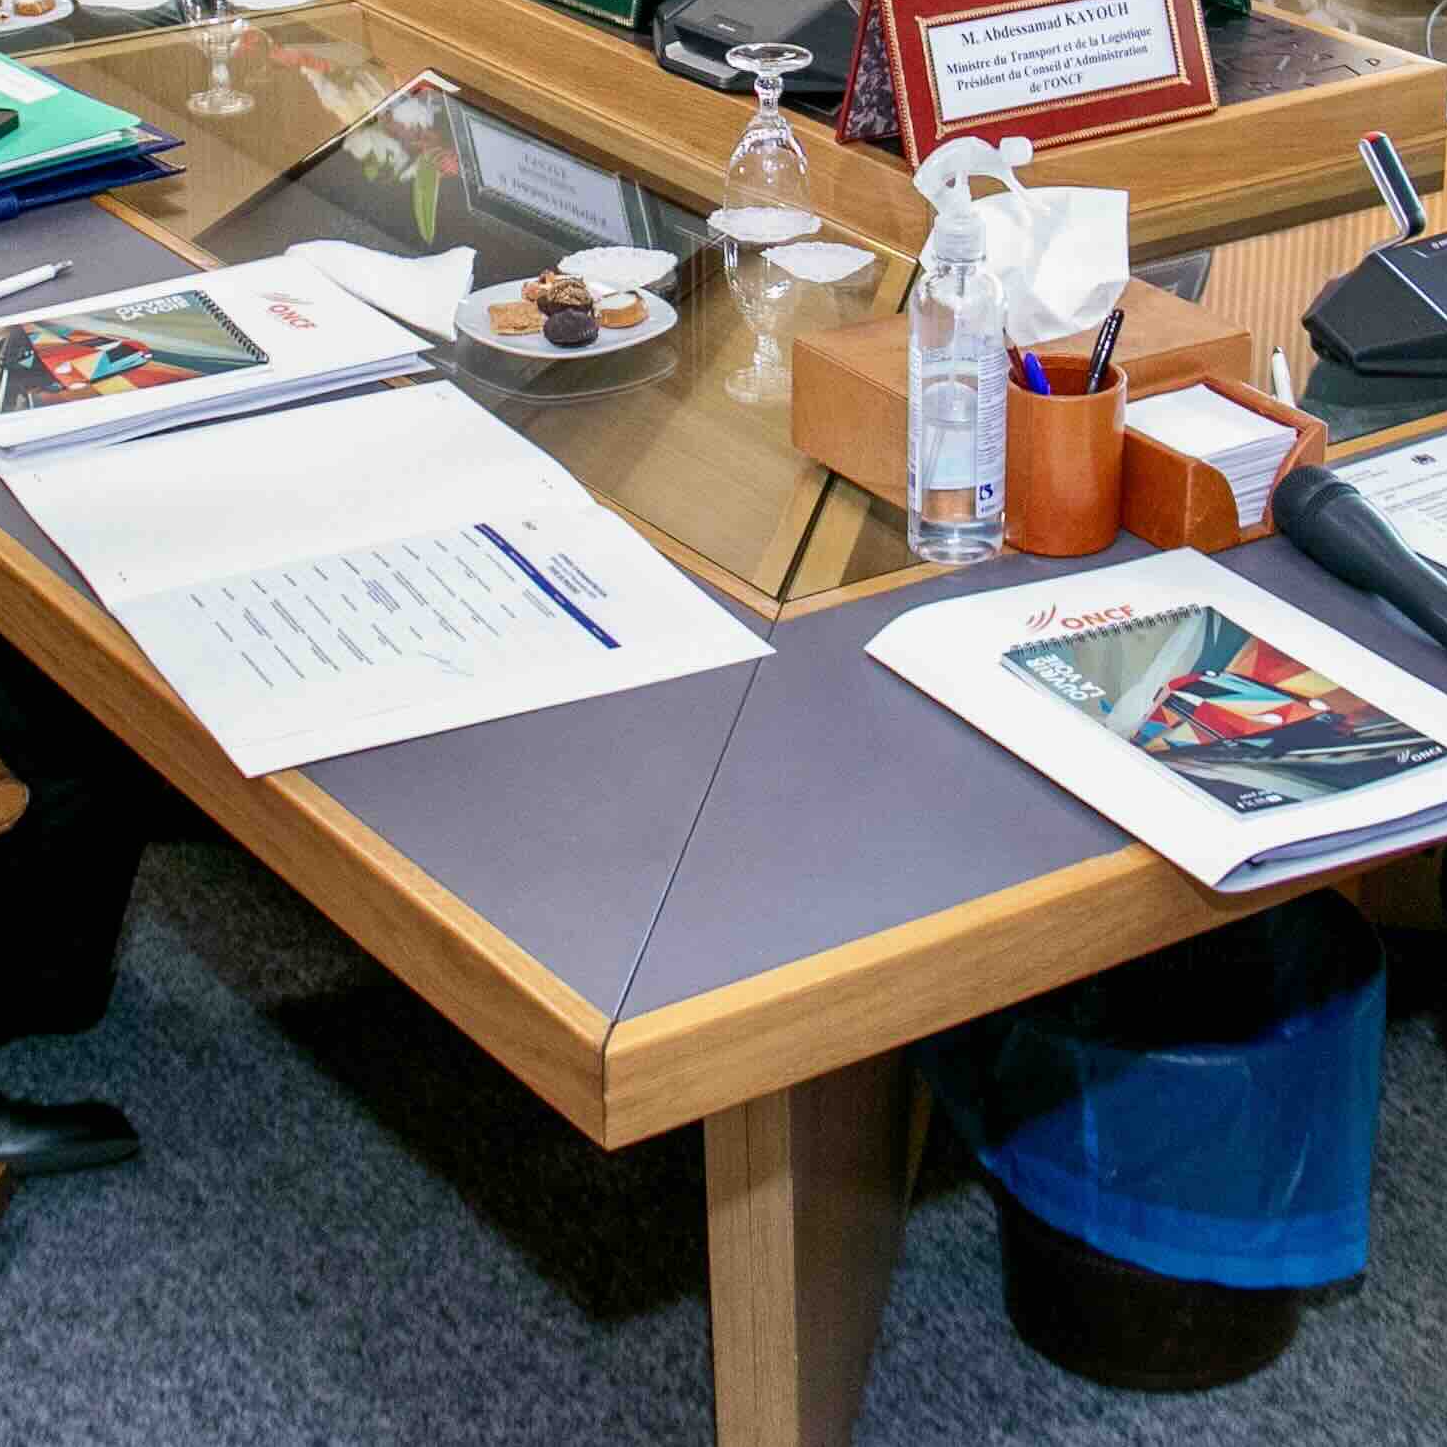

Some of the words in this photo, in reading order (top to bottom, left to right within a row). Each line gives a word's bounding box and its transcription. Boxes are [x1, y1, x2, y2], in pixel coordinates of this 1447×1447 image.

[960, 31, 981, 47] M.
[983, 16, 1061, 42] Abdessamad
[1065, 2, 1129, 26] KAYOUH
[946, 57, 992, 76] Ministre
[993, 53, 1007, 67] du
[1011, 43, 1062, 65] Transport
[1063, 41, 1074, 53] et
[1075, 36, 1088, 51] de
[1089, 33, 1099, 47] la
[1101, 25, 1153, 45] Logistique
[956, 73, 1007, 92] Président
[1008, 68, 1022, 82] du
[1024, 60, 1063, 78] Conseil
[1064, 45, 1148, 71] d'Administration
[1029, 82, 1041, 94] de
[1060, 603, 1131, 630] ONCF
